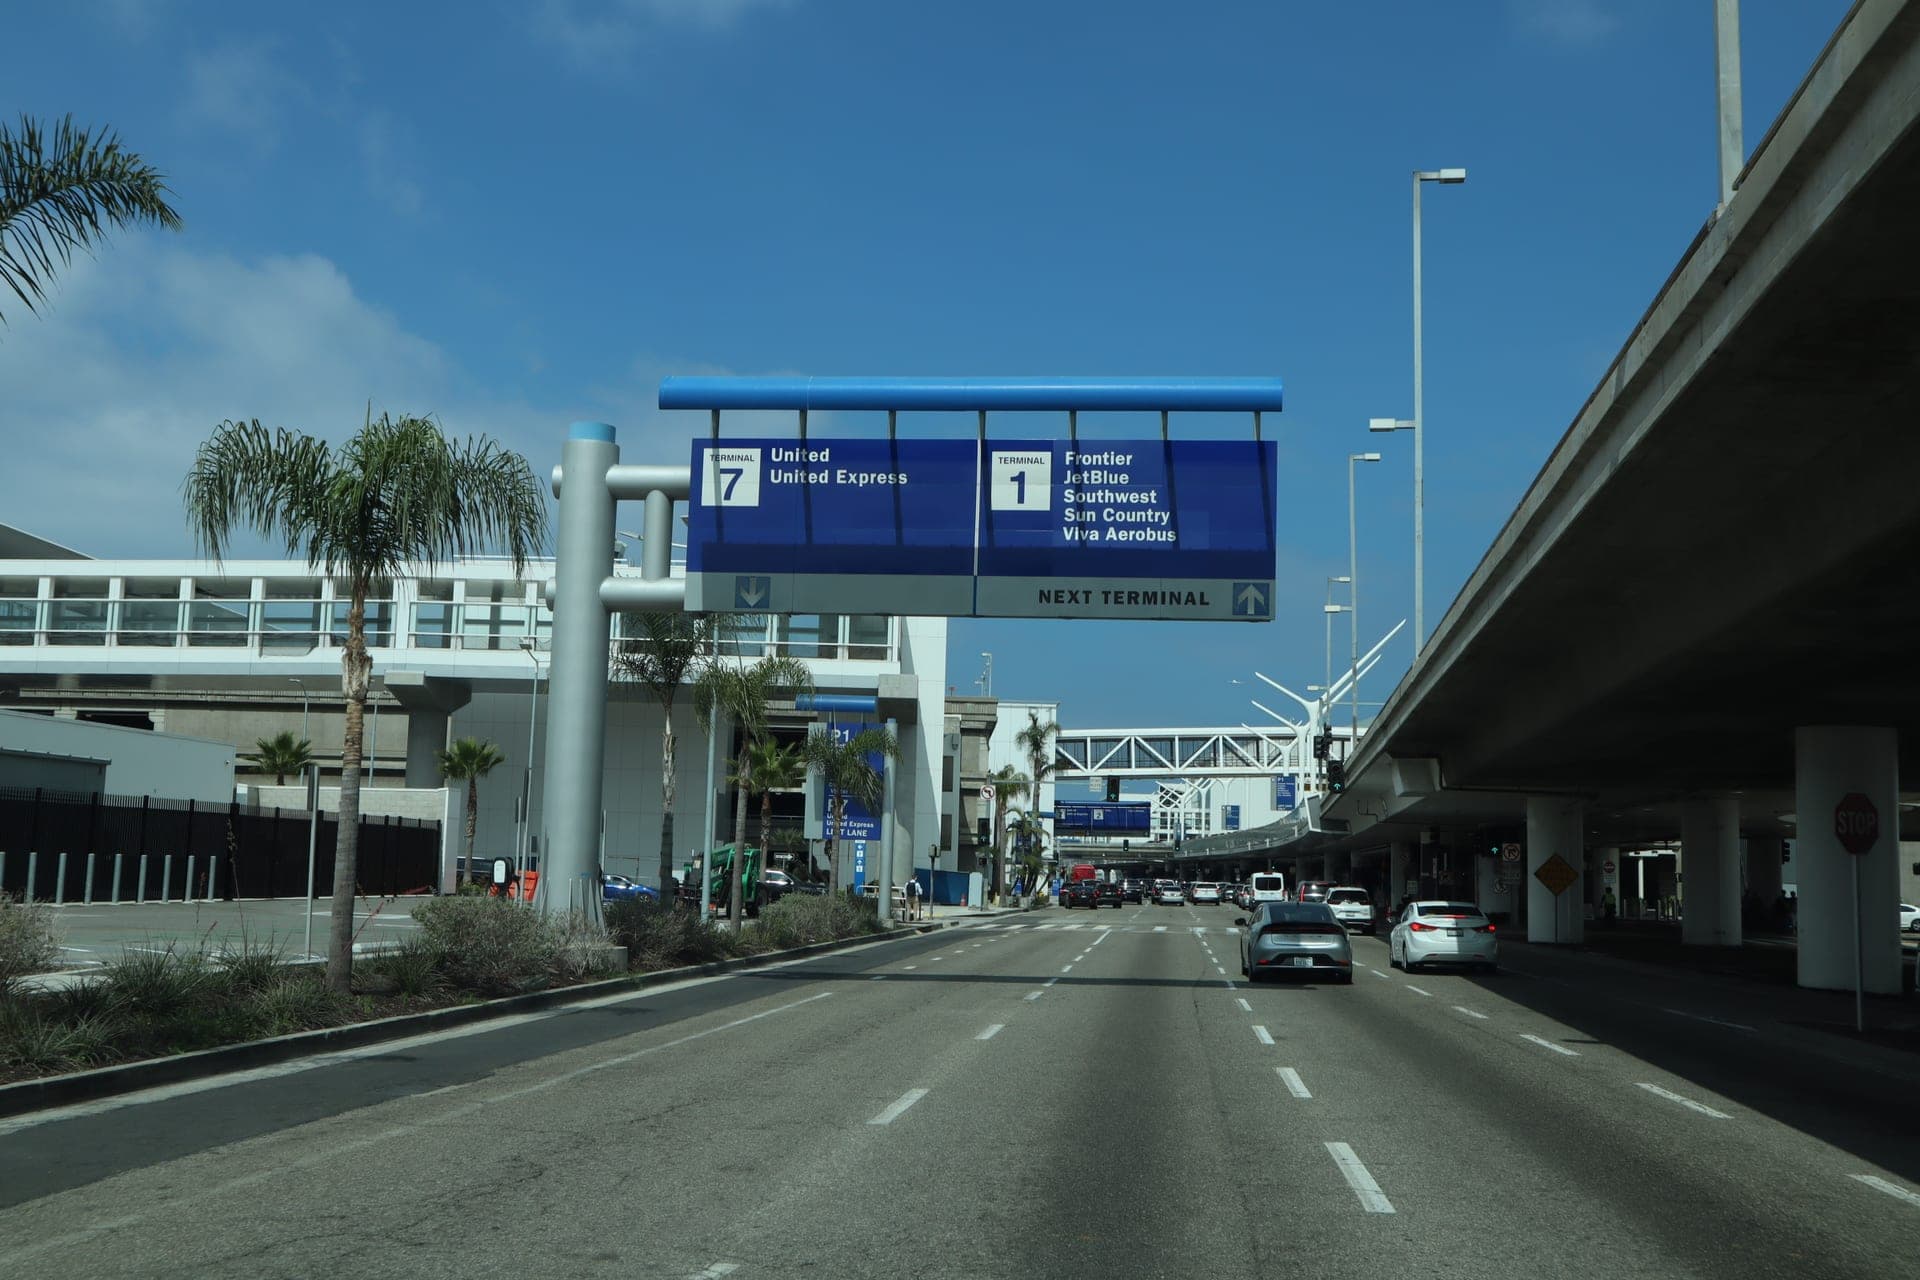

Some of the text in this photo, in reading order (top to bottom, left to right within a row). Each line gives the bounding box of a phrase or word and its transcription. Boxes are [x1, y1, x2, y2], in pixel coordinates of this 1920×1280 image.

[710, 454, 755, 462] TERMINAL
[771, 448, 829, 462] United
[998, 456, 1045, 465] TERMINAL
[1065, 451, 1133, 466] Frontier
[719, 468, 744, 501] 7
[770, 469, 908, 487] United Express
[1063, 470, 1129, 485] JetBlue
[1010, 470, 1025, 505] 1
[1063, 489, 1157, 504] Southwest
[1063, 508, 1170, 525] Sun Country
[1063, 526, 1177, 542] Viva Aerobus
[1038, 589, 1210, 606] NEXT TERMINAL
[1838, 810, 1876, 836] STOP
[826, 828, 868, 837] LT LANE
